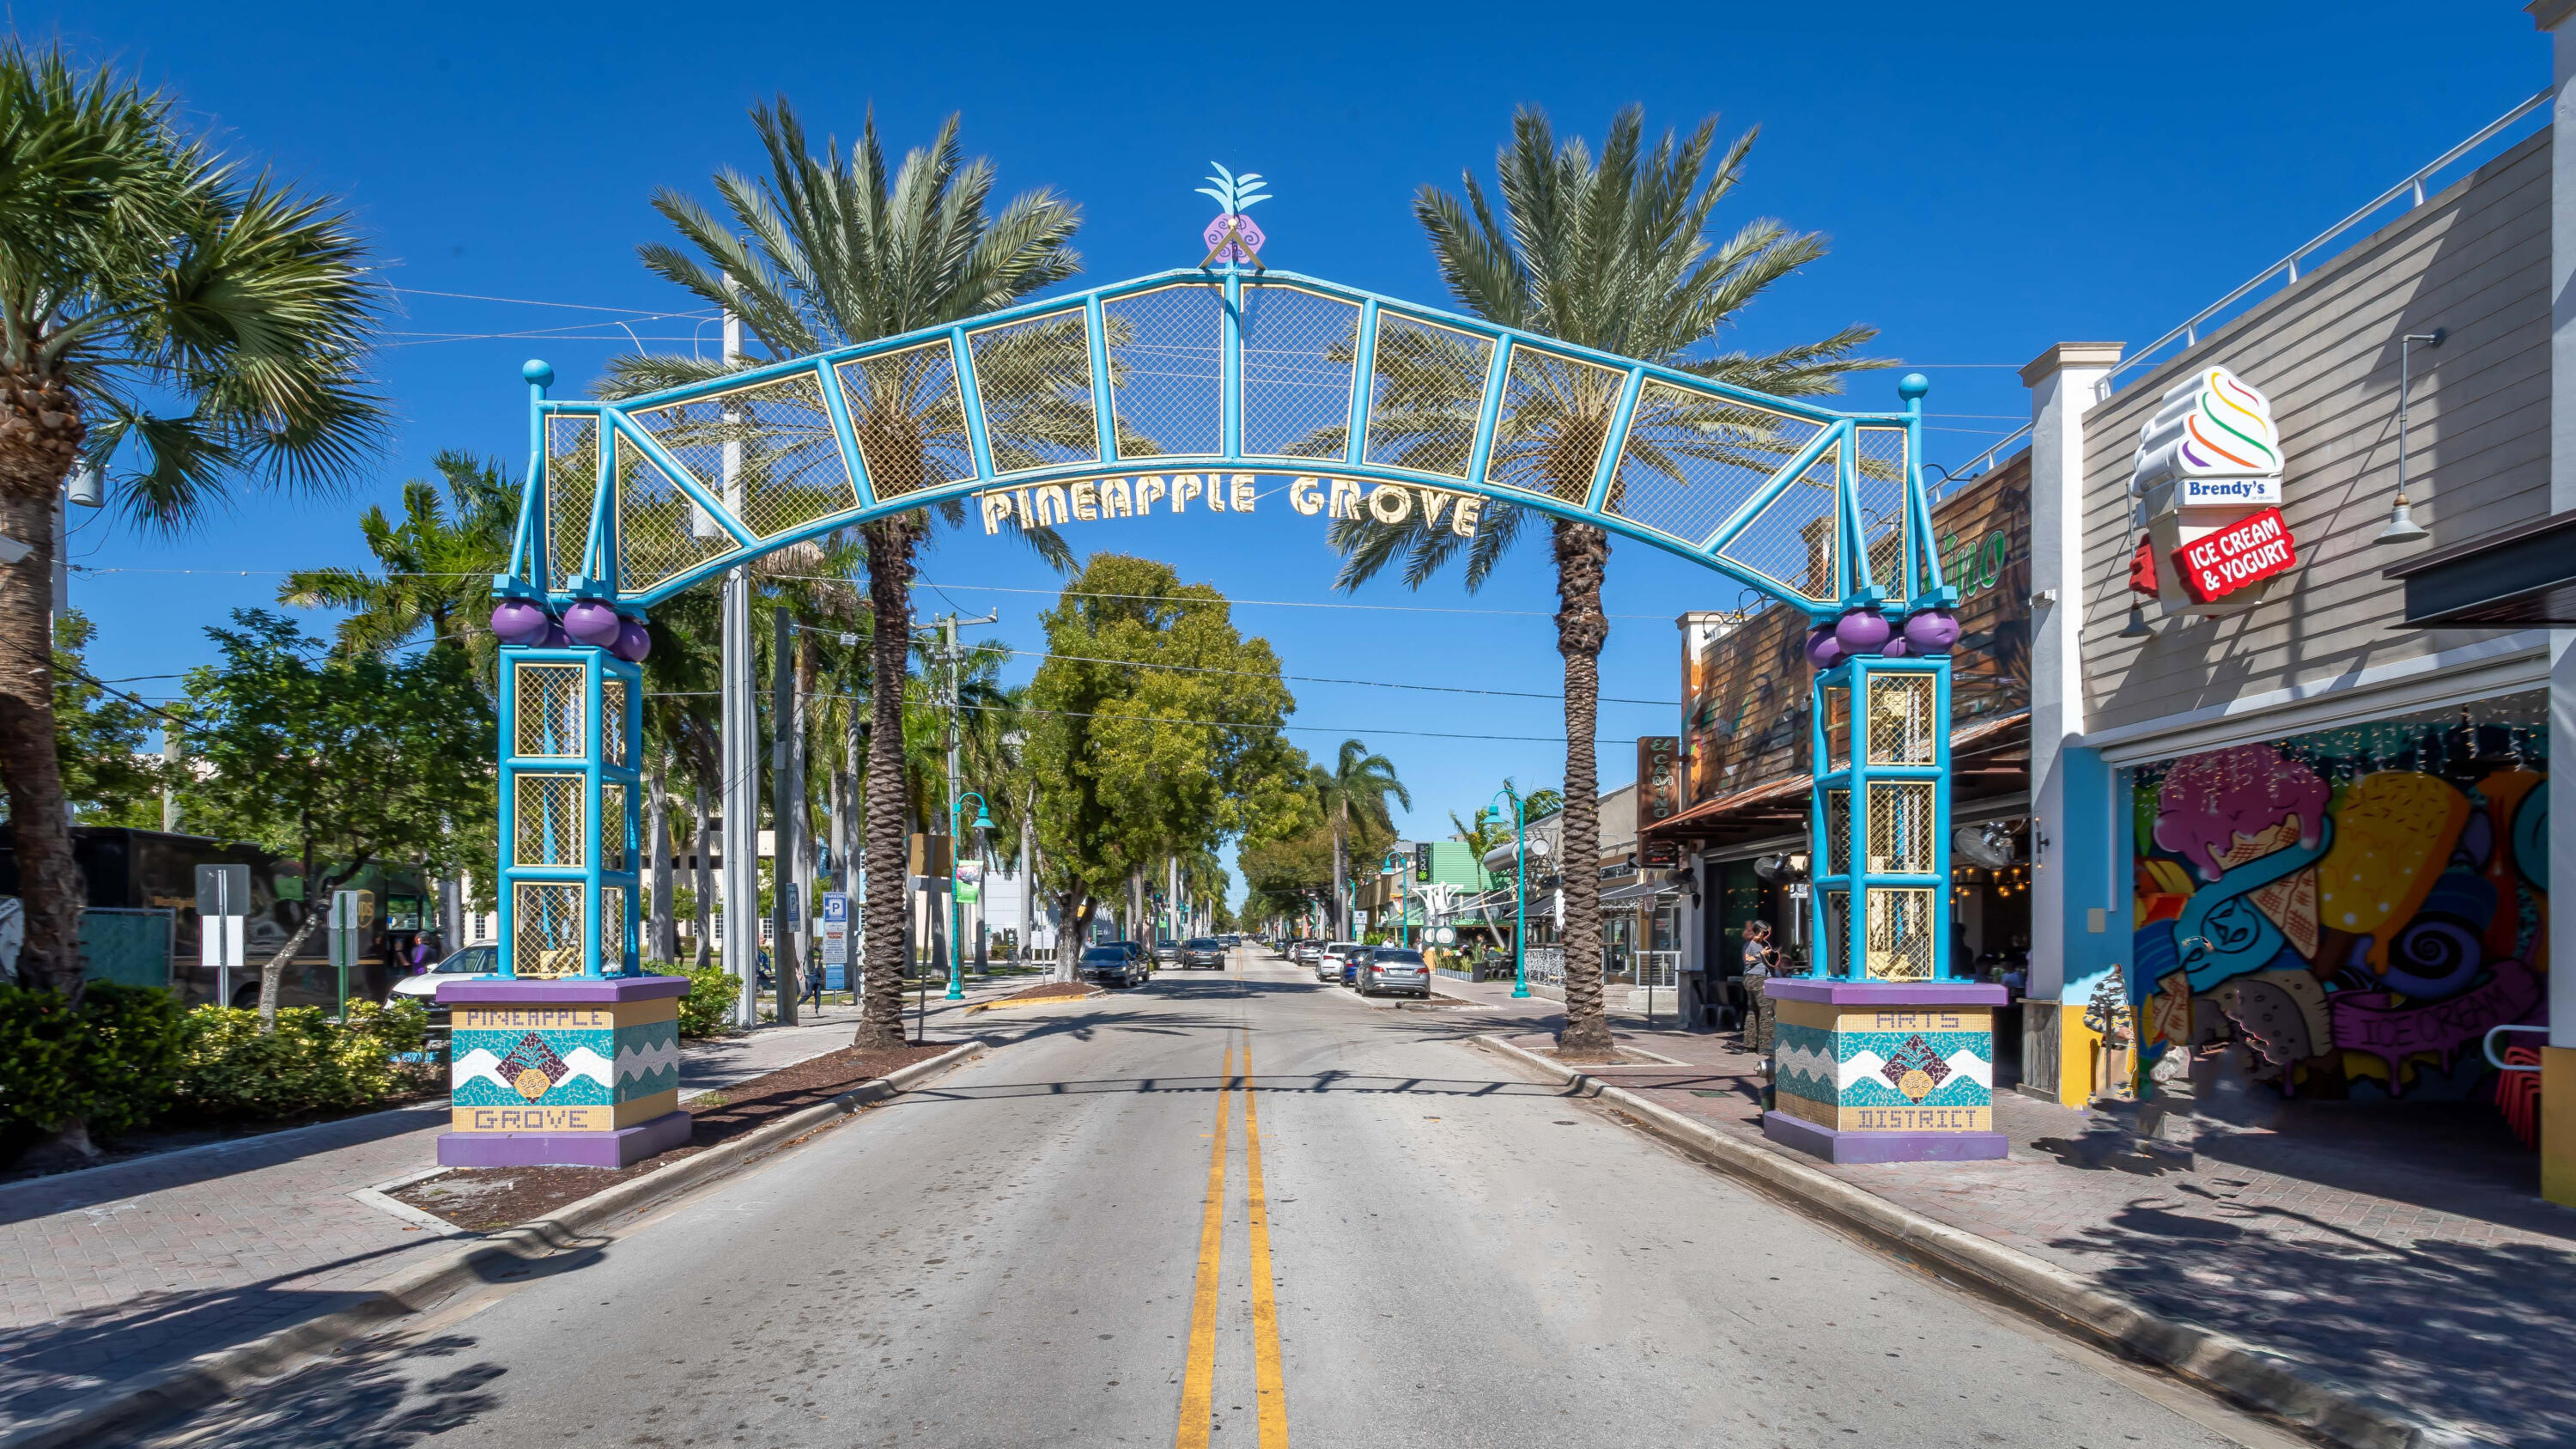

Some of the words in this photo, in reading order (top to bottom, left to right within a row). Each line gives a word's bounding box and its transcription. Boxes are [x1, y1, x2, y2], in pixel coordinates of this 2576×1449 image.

[2189, 481, 2265, 497] Brendy's
[981, 474, 1255, 536] PINEAPPLE
[1291, 476, 1479, 538] GROVE
[2189, 542, 2221, 569] ICE
[2220, 516, 2281, 557] CREAM
[2202, 570, 2221, 591] &
[2219, 539, 2289, 583] YOGURT
[1650, 739, 1673, 752] El
[1652, 754, 1674, 819] CAMINO
[833, 903, 840, 913] P
[467, 1008, 605, 1026] PINEAPPLE
[1876, 1011, 1959, 1028] ARTS
[2360, 1015, 2415, 1046] ICE
[2416, 984, 2520, 1043] CREAM
[475, 1110, 588, 1129] GROVE
[1858, 1110, 1977, 1129] DISTRICT
